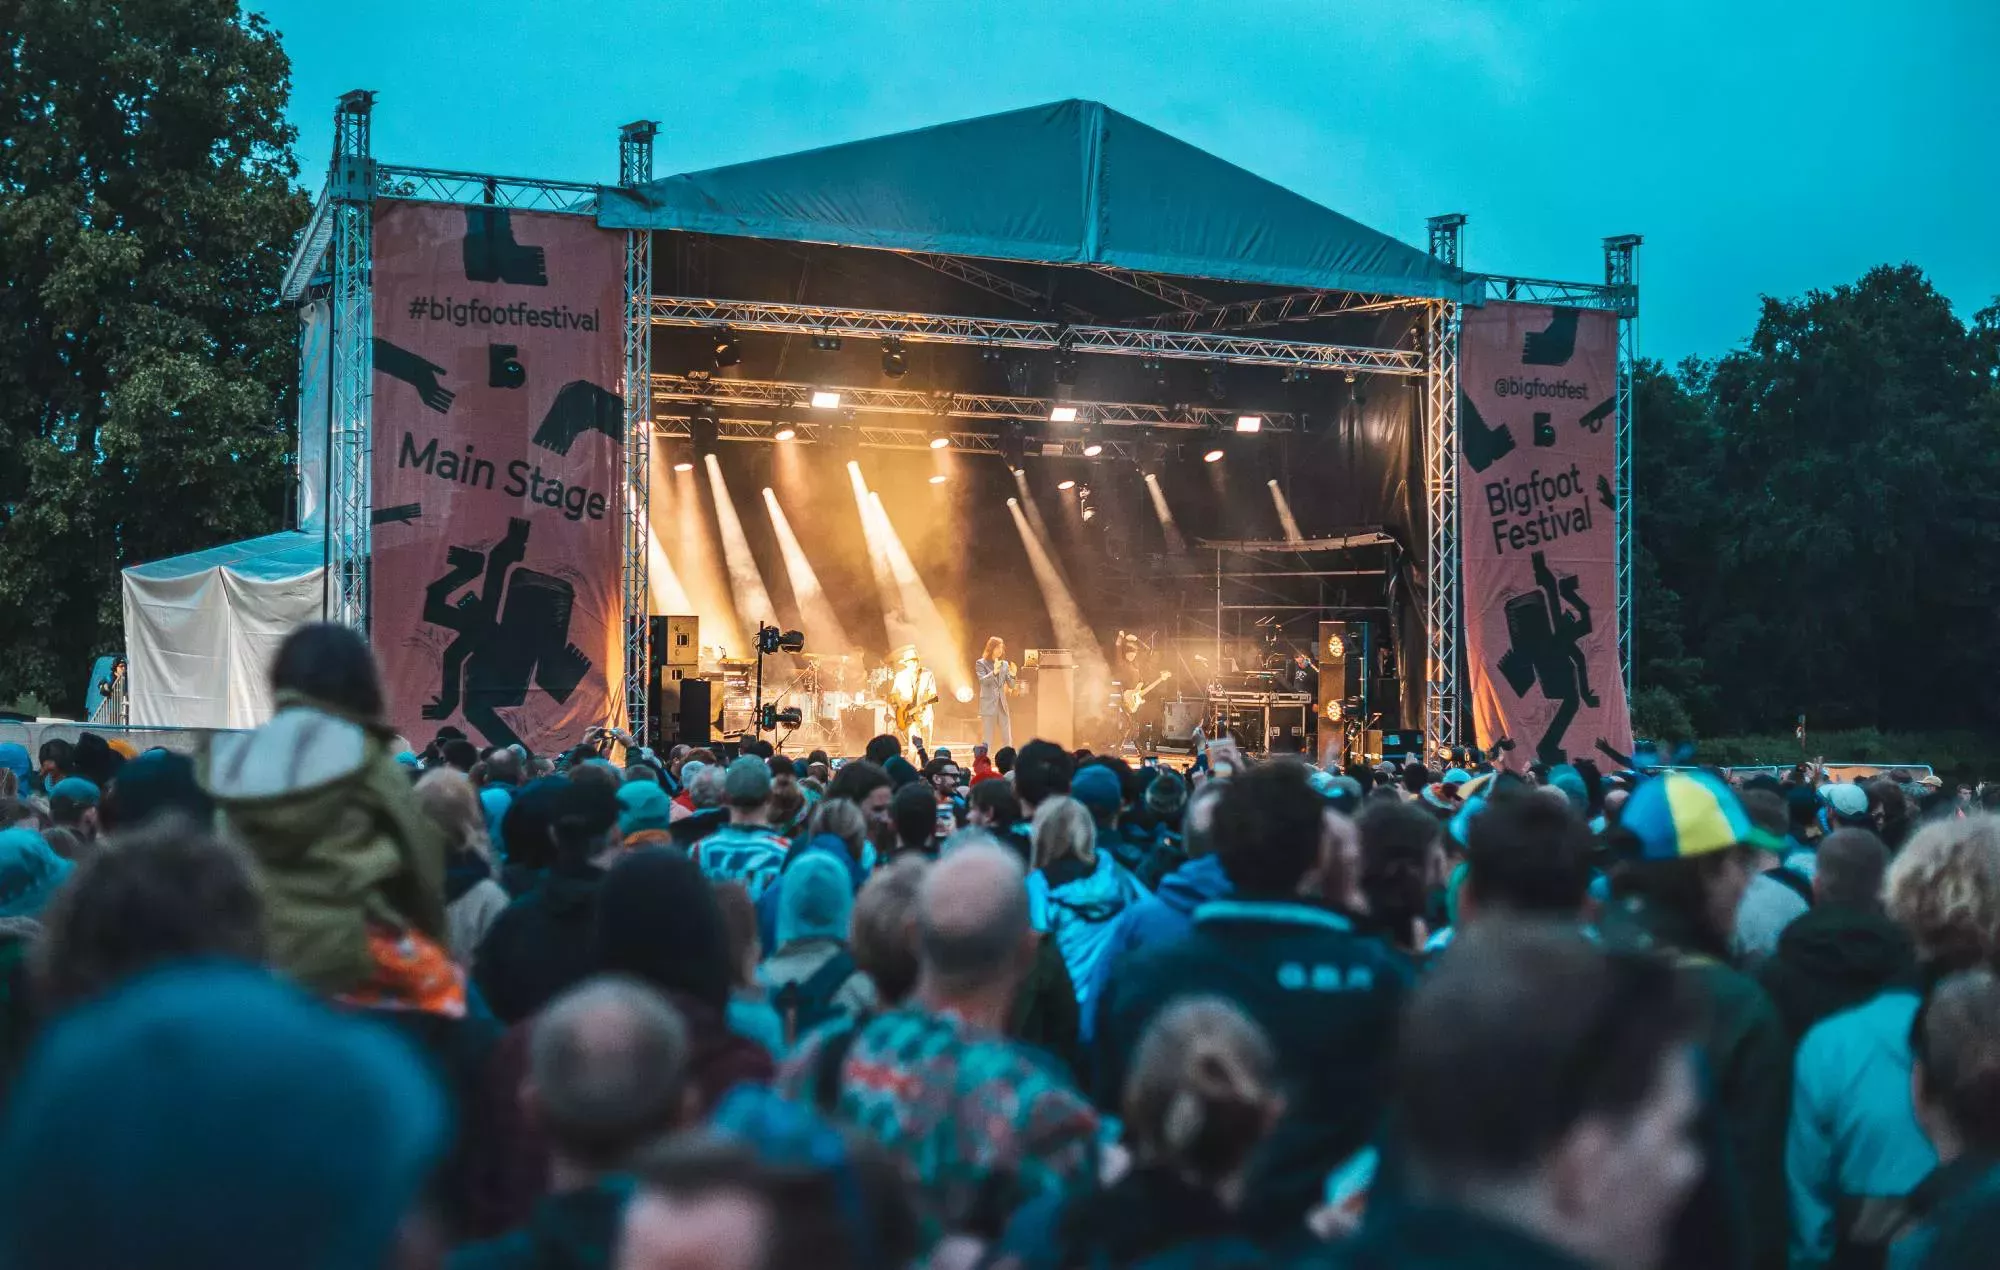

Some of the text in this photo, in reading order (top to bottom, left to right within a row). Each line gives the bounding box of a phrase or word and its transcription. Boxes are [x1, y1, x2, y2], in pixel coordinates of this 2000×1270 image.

[409, 296, 600, 332] #bigfootfestival
[1495, 376, 1589, 400] @bigfootfest
[398, 431, 606, 521] Main Stage
[1485, 463, 1583, 516] Bigfoot
[1492, 495, 1592, 555] Festival
